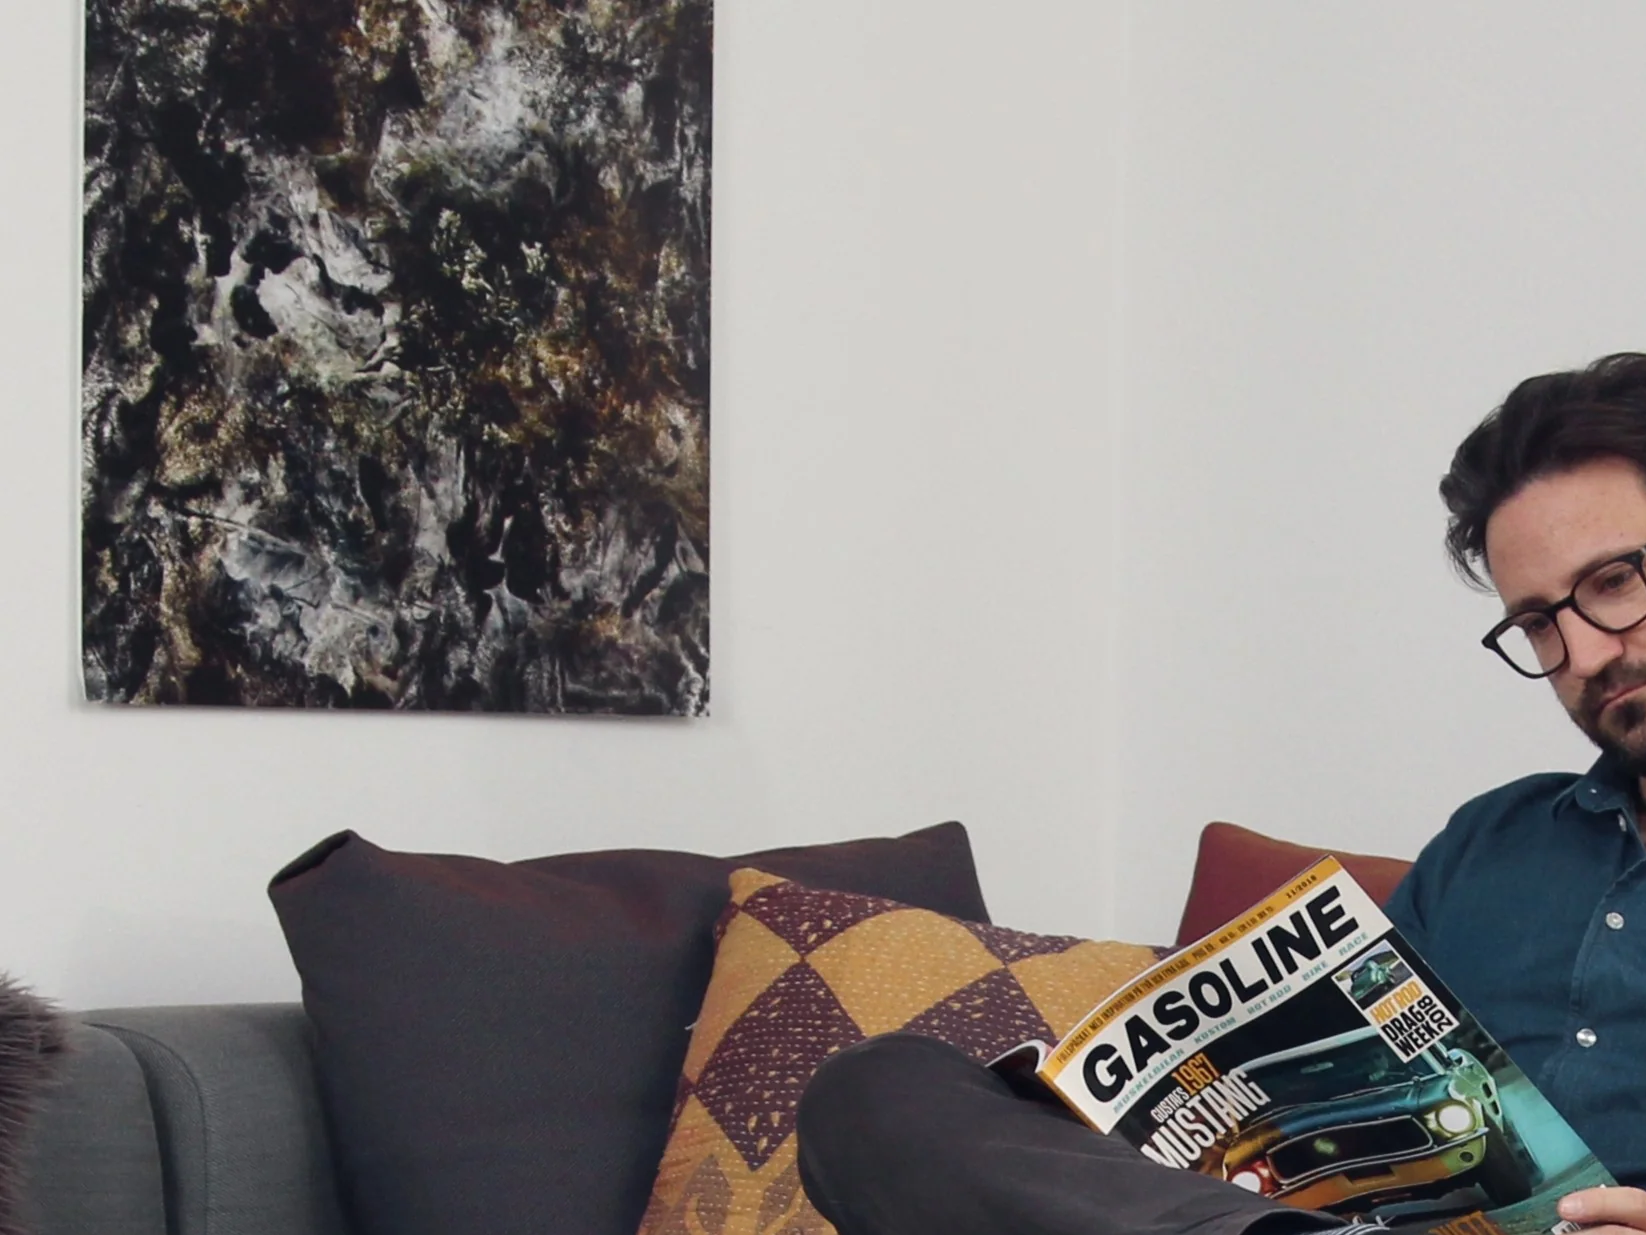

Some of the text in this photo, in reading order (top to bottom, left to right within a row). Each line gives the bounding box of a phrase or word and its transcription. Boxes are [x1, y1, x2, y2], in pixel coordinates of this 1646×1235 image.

[1084, 886, 1360, 1103] GASOLINE
[1246, 999, 1268, 1015] HOT
[1301, 960, 1329, 982] BIKE
[1338, 931, 1369, 956] RACE
[1370, 980, 1424, 1024] HOT ROD
[1380, 1004, 1427, 1042] DRAG
[1394, 1020, 1440, 1057] WEEK
[1416, 993, 1455, 1032] 2018
[1140, 1064, 1272, 1169] MUSTANG
[1150, 1051, 1221, 1124] GUSTAFS 1967
